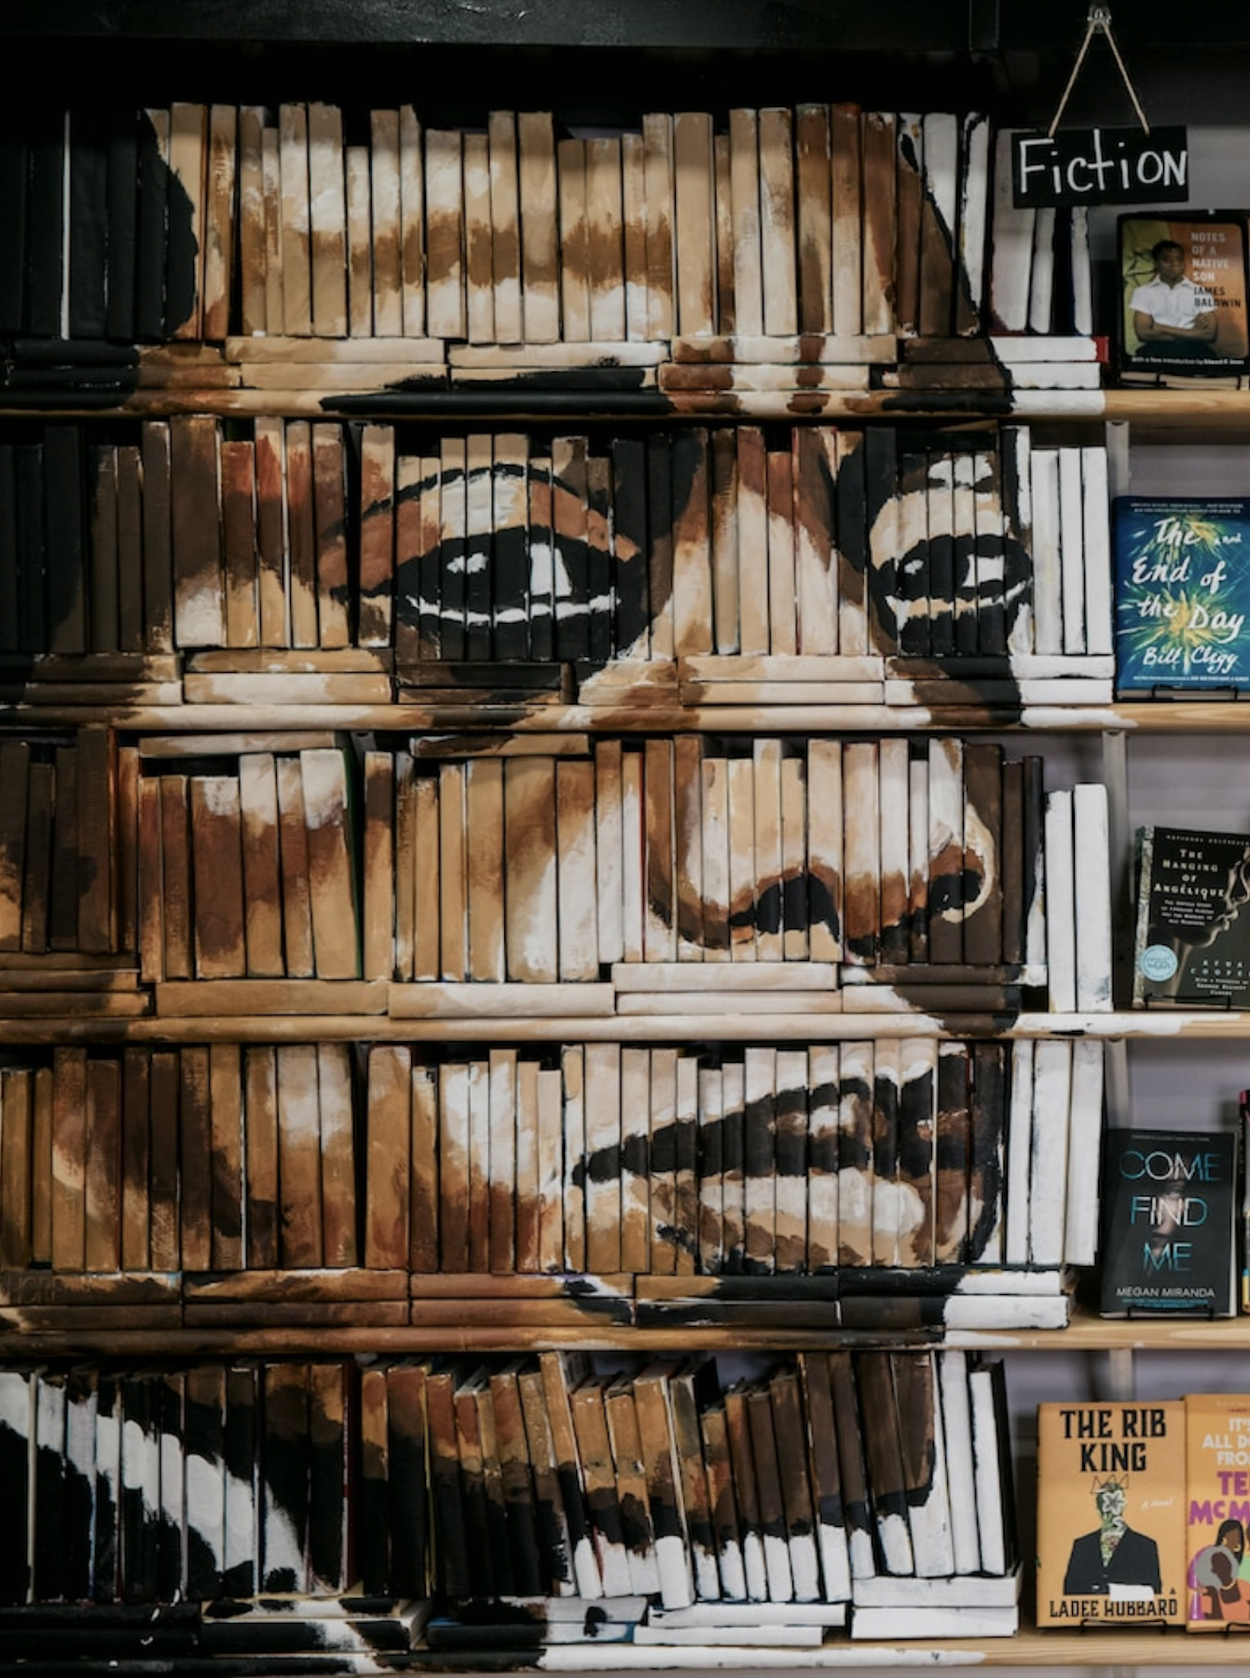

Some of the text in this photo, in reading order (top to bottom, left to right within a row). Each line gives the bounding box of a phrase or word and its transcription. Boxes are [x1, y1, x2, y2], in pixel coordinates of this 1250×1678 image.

[1019, 128, 1187, 194] Fiction
[1191, 232, 1225, 242] NOTES
[1192, 246, 1216, 255] OF A
[1192, 258, 1229, 269] NATIVE
[1192, 271, 1215, 281] SON
[1194, 287, 1225, 296] JAMES
[1194, 298, 1241, 308] BALDWIN
[1154, 517, 1201, 545] The
[1133, 556, 1227, 594] End of
[1137, 594, 1245, 644] the Day
[1142, 646, 1238, 674] Bill Clegg
[1202, 959, 1243, 967] AFUA
[1119, 1150, 1222, 1181] COME
[1130, 1196, 1208, 1226] FIND
[1142, 1242, 1192, 1271] ME
[1117, 1286, 1215, 1298] MEGAN MIRANDA
[1060, 1409, 1166, 1439] THE RIB
[1202, 1434, 1233, 1449] ALL
[1080, 1442, 1146, 1472] KING
[1050, 1599, 1178, 1618] LADEE HUBBARD
